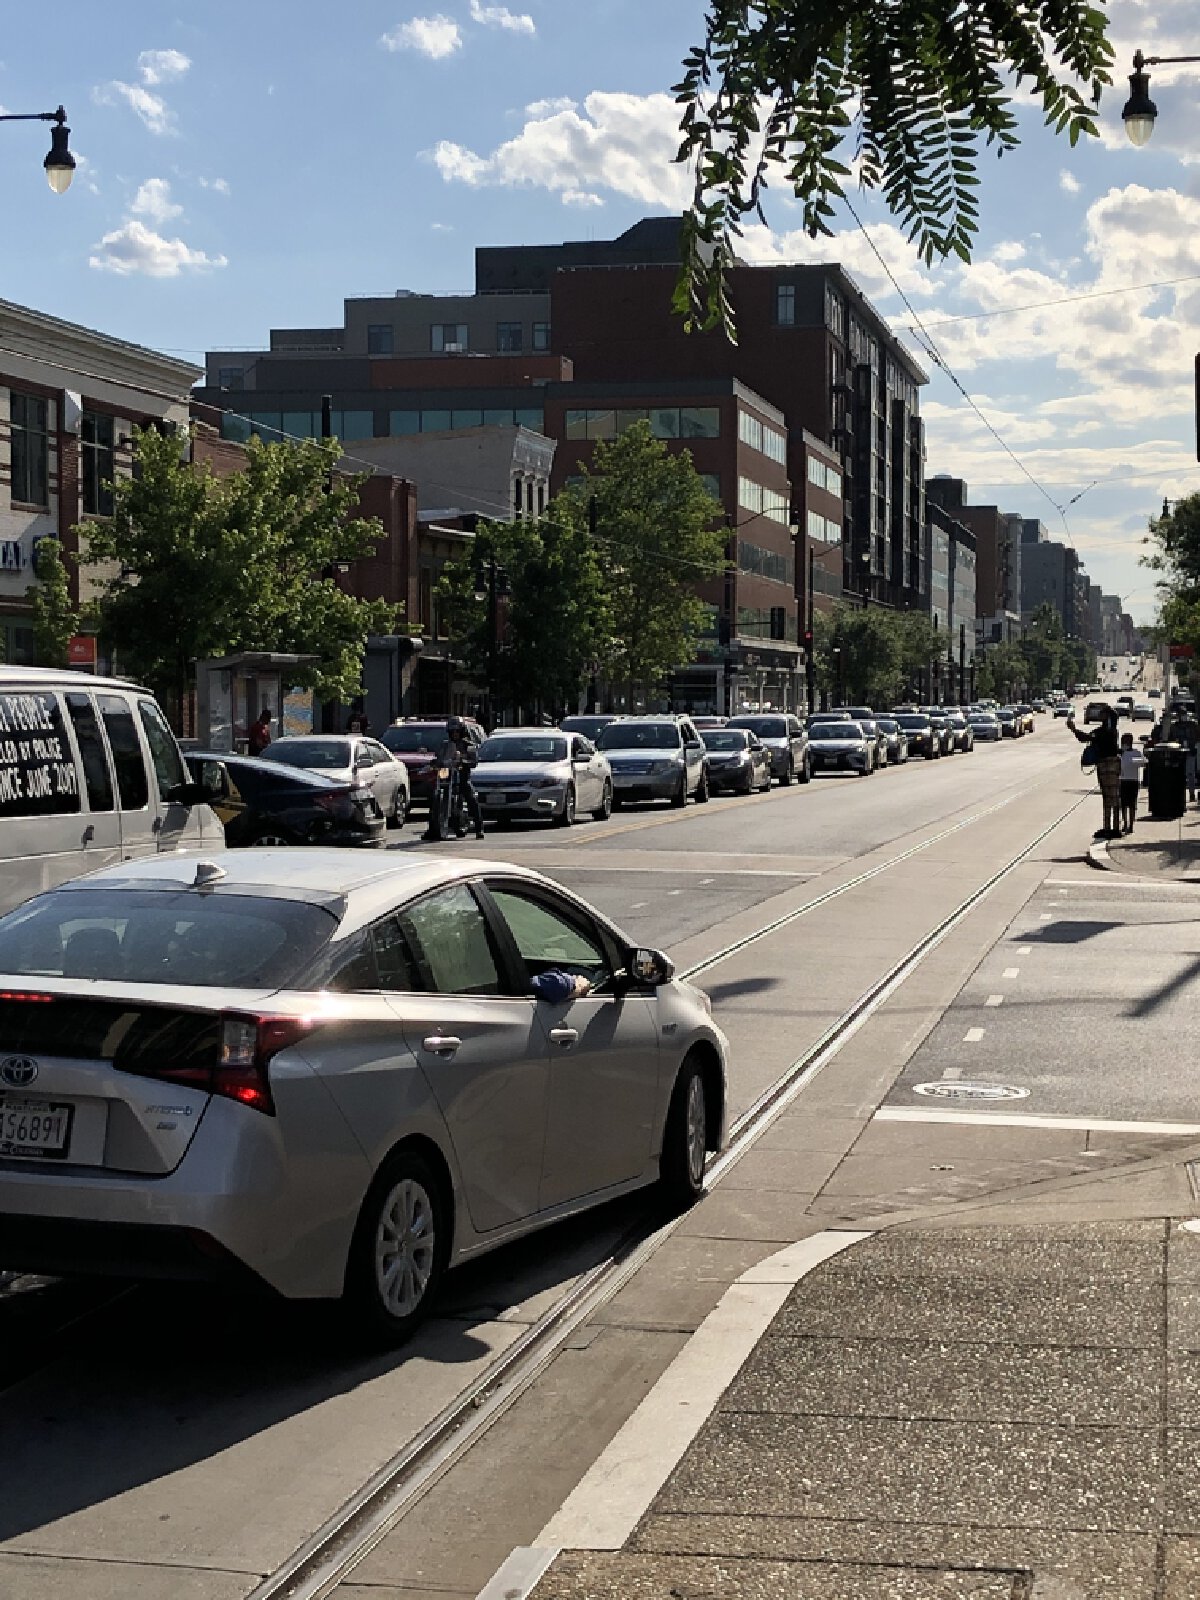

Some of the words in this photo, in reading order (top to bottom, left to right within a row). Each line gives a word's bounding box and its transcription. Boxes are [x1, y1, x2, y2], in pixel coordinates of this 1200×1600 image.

[5, 696, 54, 731] PEOPLE
[0, 740, 18, 763] LED
[33, 737, 62, 760] POLICE
[26, 764, 52, 798] JUNE
